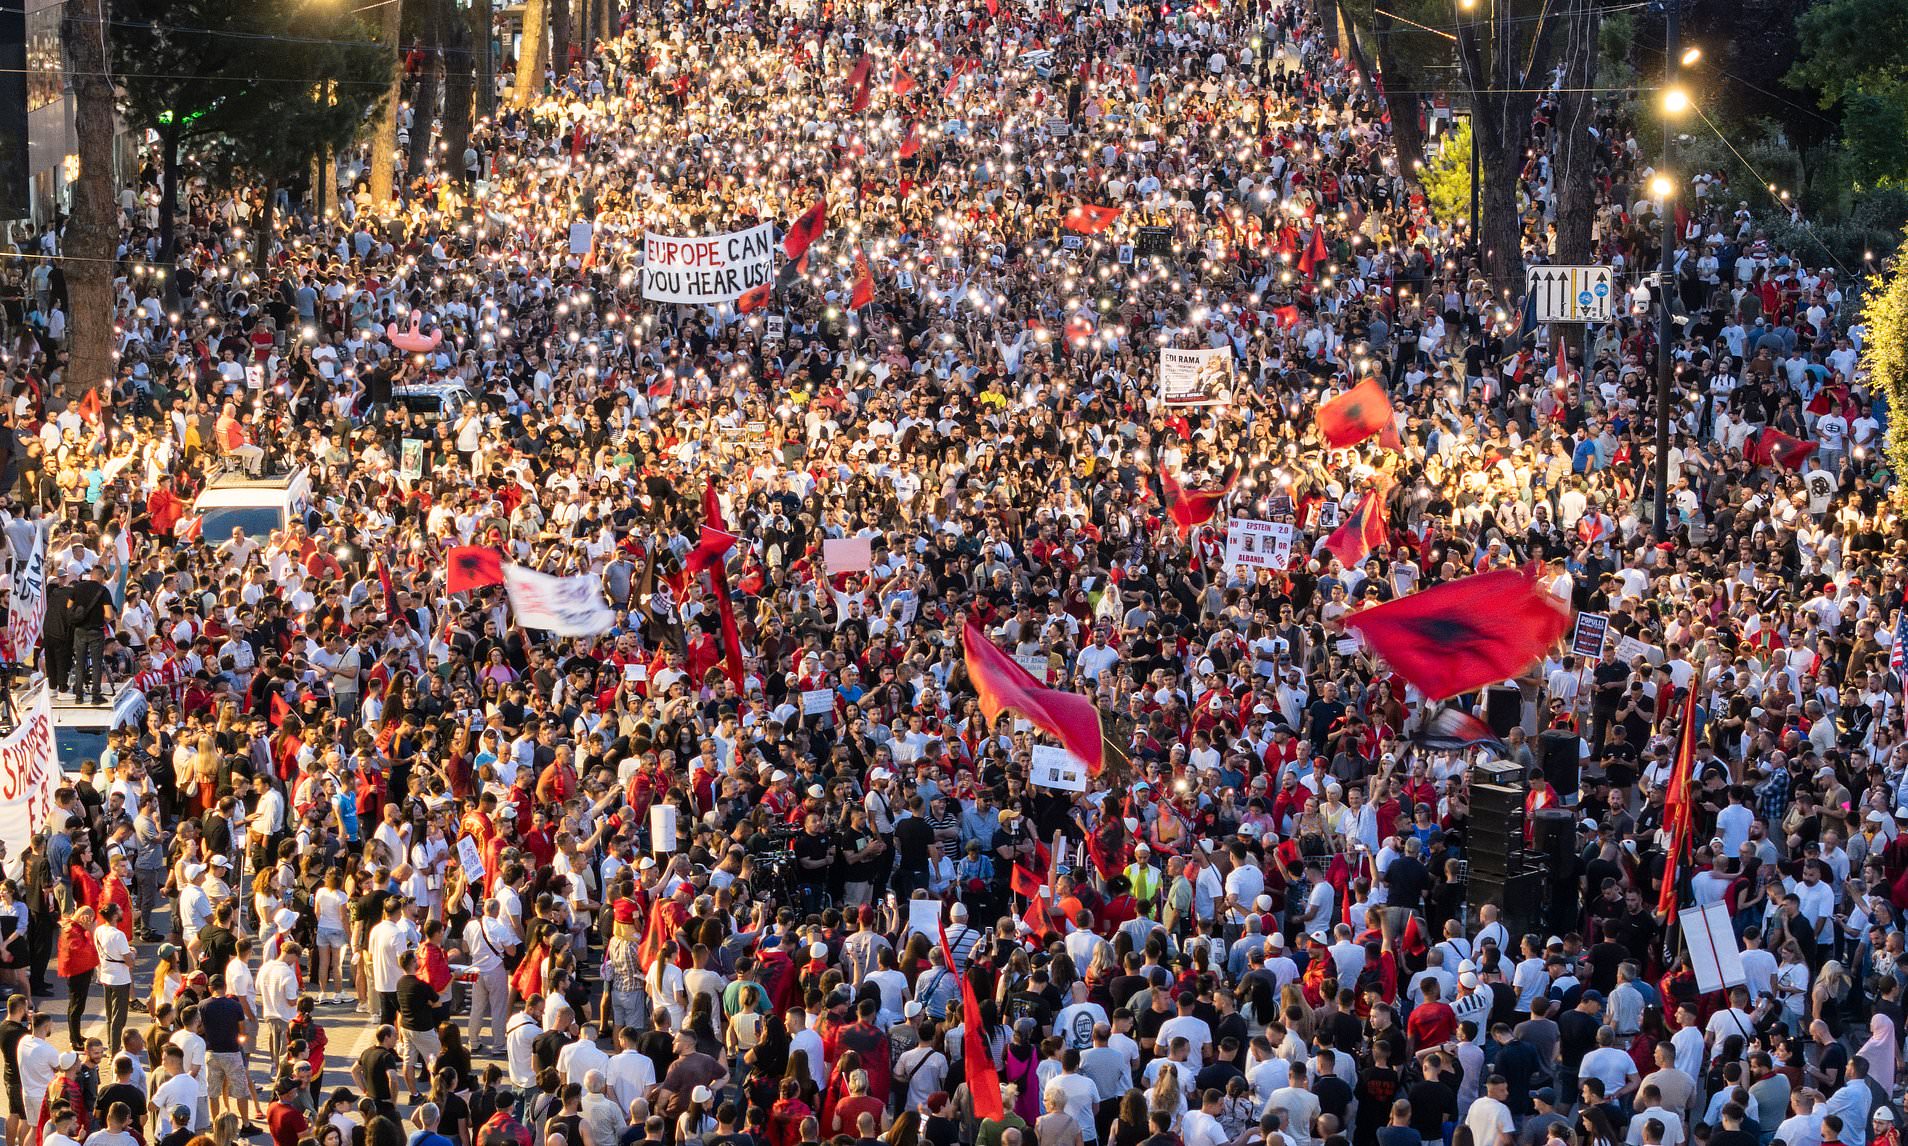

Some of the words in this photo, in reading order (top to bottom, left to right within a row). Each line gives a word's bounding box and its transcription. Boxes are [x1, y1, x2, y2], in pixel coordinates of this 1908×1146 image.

[648, 239, 725, 267] EUROPE,
[728, 230, 769, 262] CAN
[647, 268, 680, 294] YOU
[687, 269, 742, 295] HEAR
[1165, 354, 1176, 362] EDI
[1178, 355, 1200, 364] RAMA
[1230, 520, 1239, 528] NO
[1246, 522, 1272, 532] EPSTEIN
[1278, 526, 1289, 534] 2.0
[1278, 542, 1288, 550] OR
[1238, 554, 1265, 564] ALBANIA
[1580, 616, 1604, 627] POPULLI
